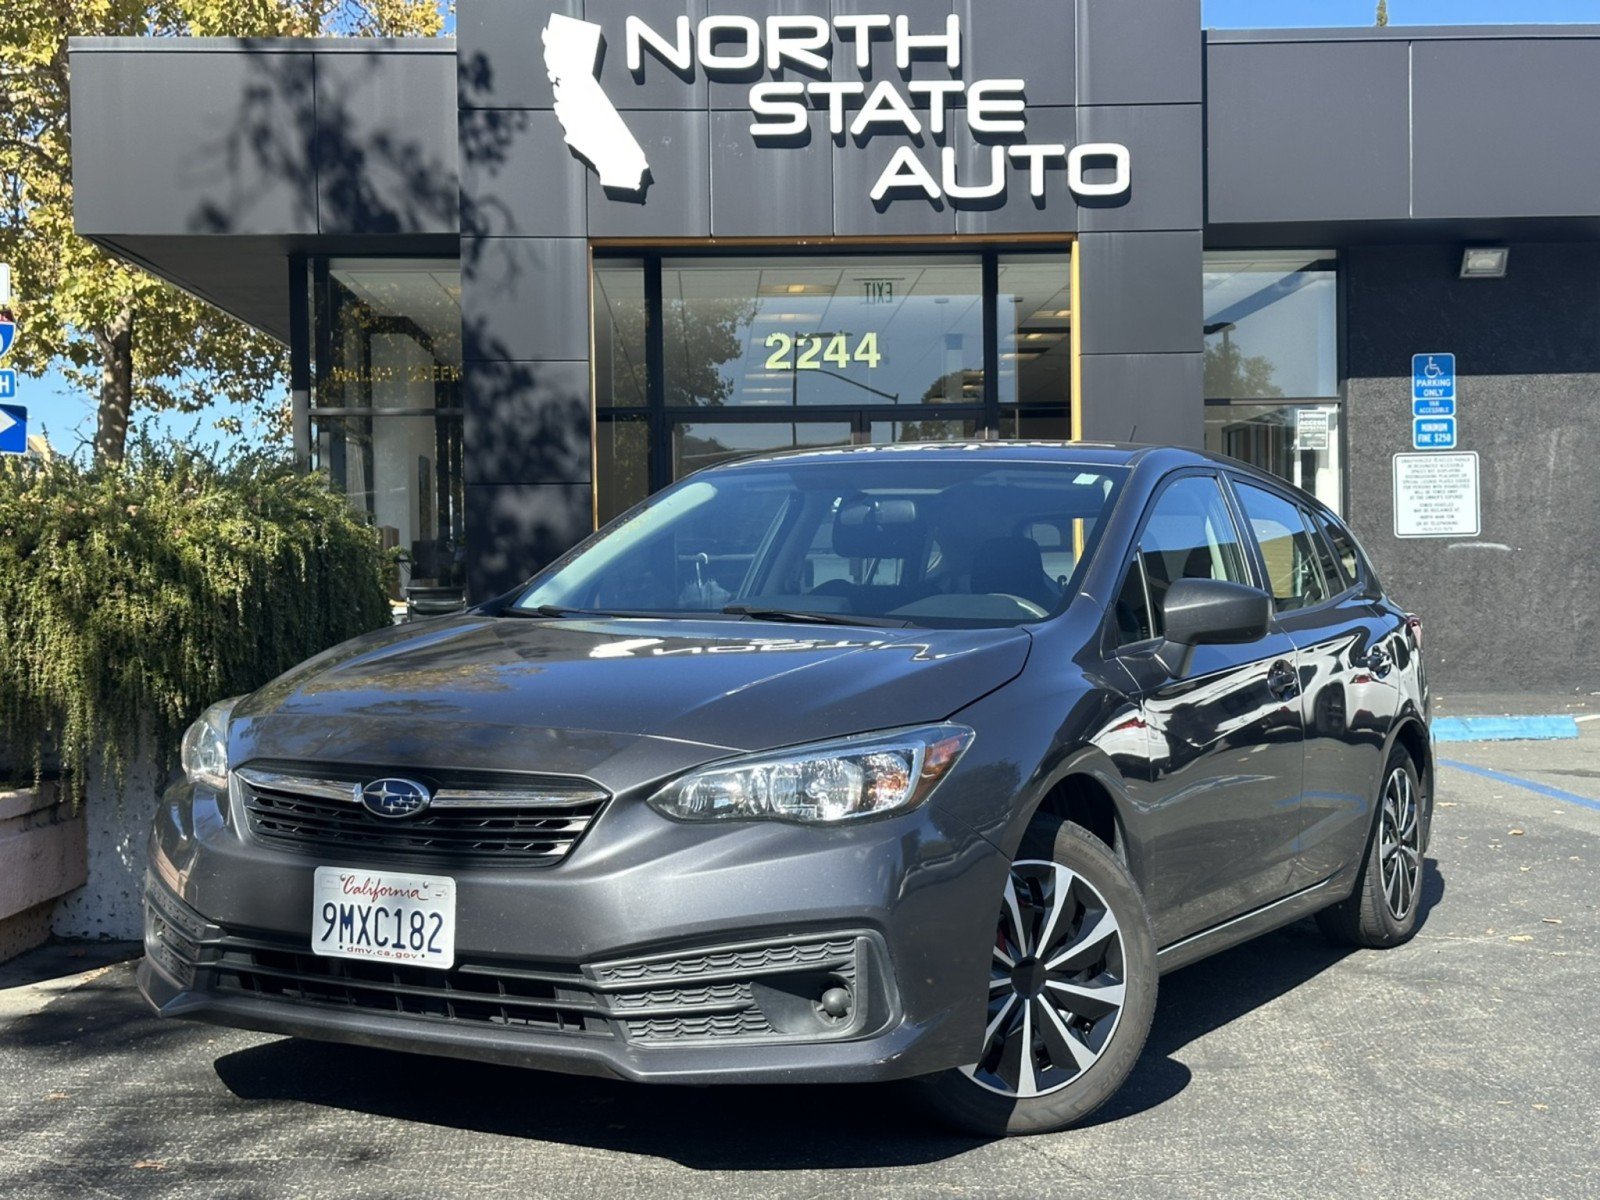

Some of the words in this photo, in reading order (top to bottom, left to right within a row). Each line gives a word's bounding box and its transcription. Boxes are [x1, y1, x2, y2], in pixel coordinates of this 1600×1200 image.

[626, 14, 960, 70] NORTH
[748, 79, 1026, 136] STATE
[869, 142, 1131, 201] AUTO
[764, 332, 881, 369] 2244
[1416, 379, 1451, 387] PARKING
[1423, 388, 1444, 397] ONLY
[1418, 433, 1432, 443] FINE
[1434, 433, 1452, 443] $250
[343, 875, 429, 903] California
[321, 902, 443, 954] 9MXC182
[346, 945, 418, 959] dmv.ca.gov
